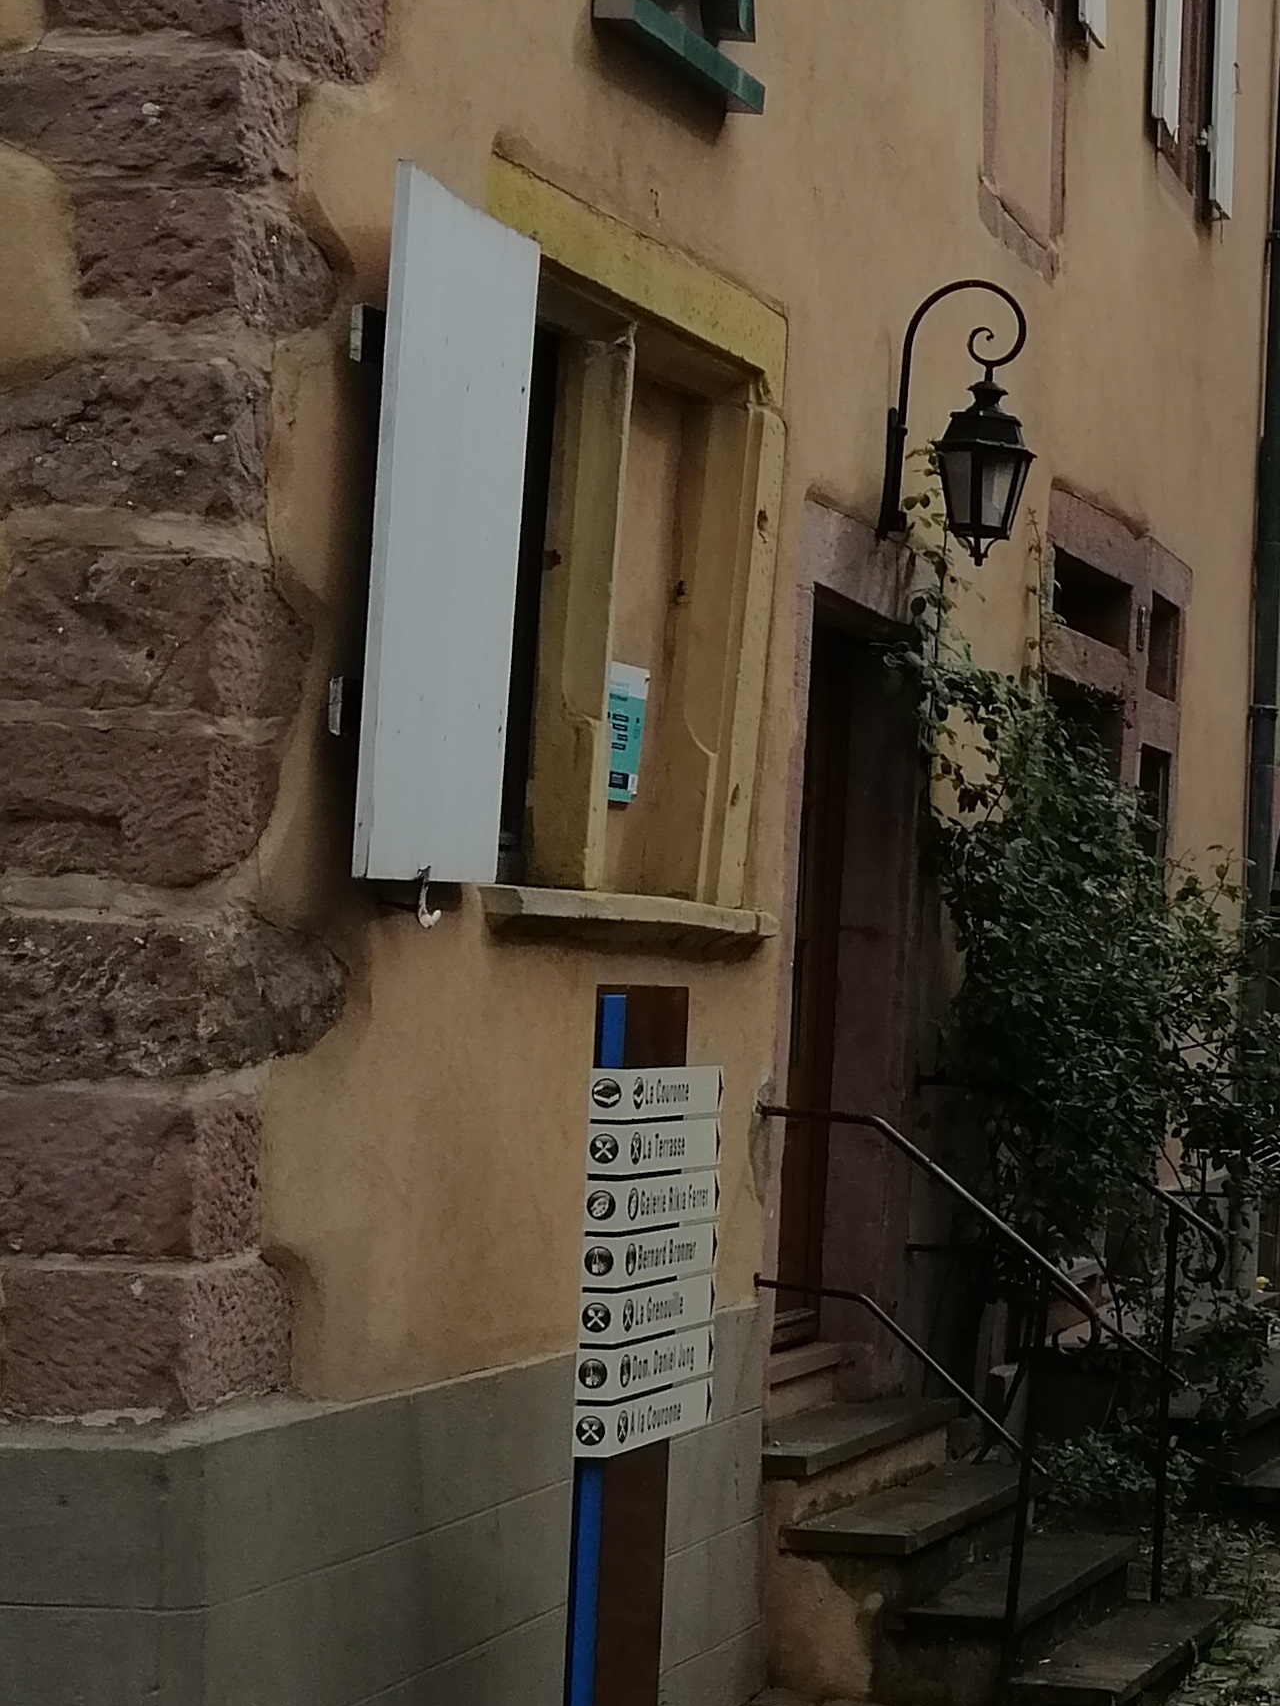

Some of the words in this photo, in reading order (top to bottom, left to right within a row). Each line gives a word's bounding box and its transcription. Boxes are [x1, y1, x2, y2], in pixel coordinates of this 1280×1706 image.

[645, 1078, 654, 1106] La
[642, 1134, 652, 1161] La
[655, 1133, 685, 1159] Terrasse
[640, 1189, 667, 1217] Galerie
[637, 1240, 668, 1271] Bernard
[634, 1300, 645, 1326] La
[653, 1345, 677, 1376] Daniel
